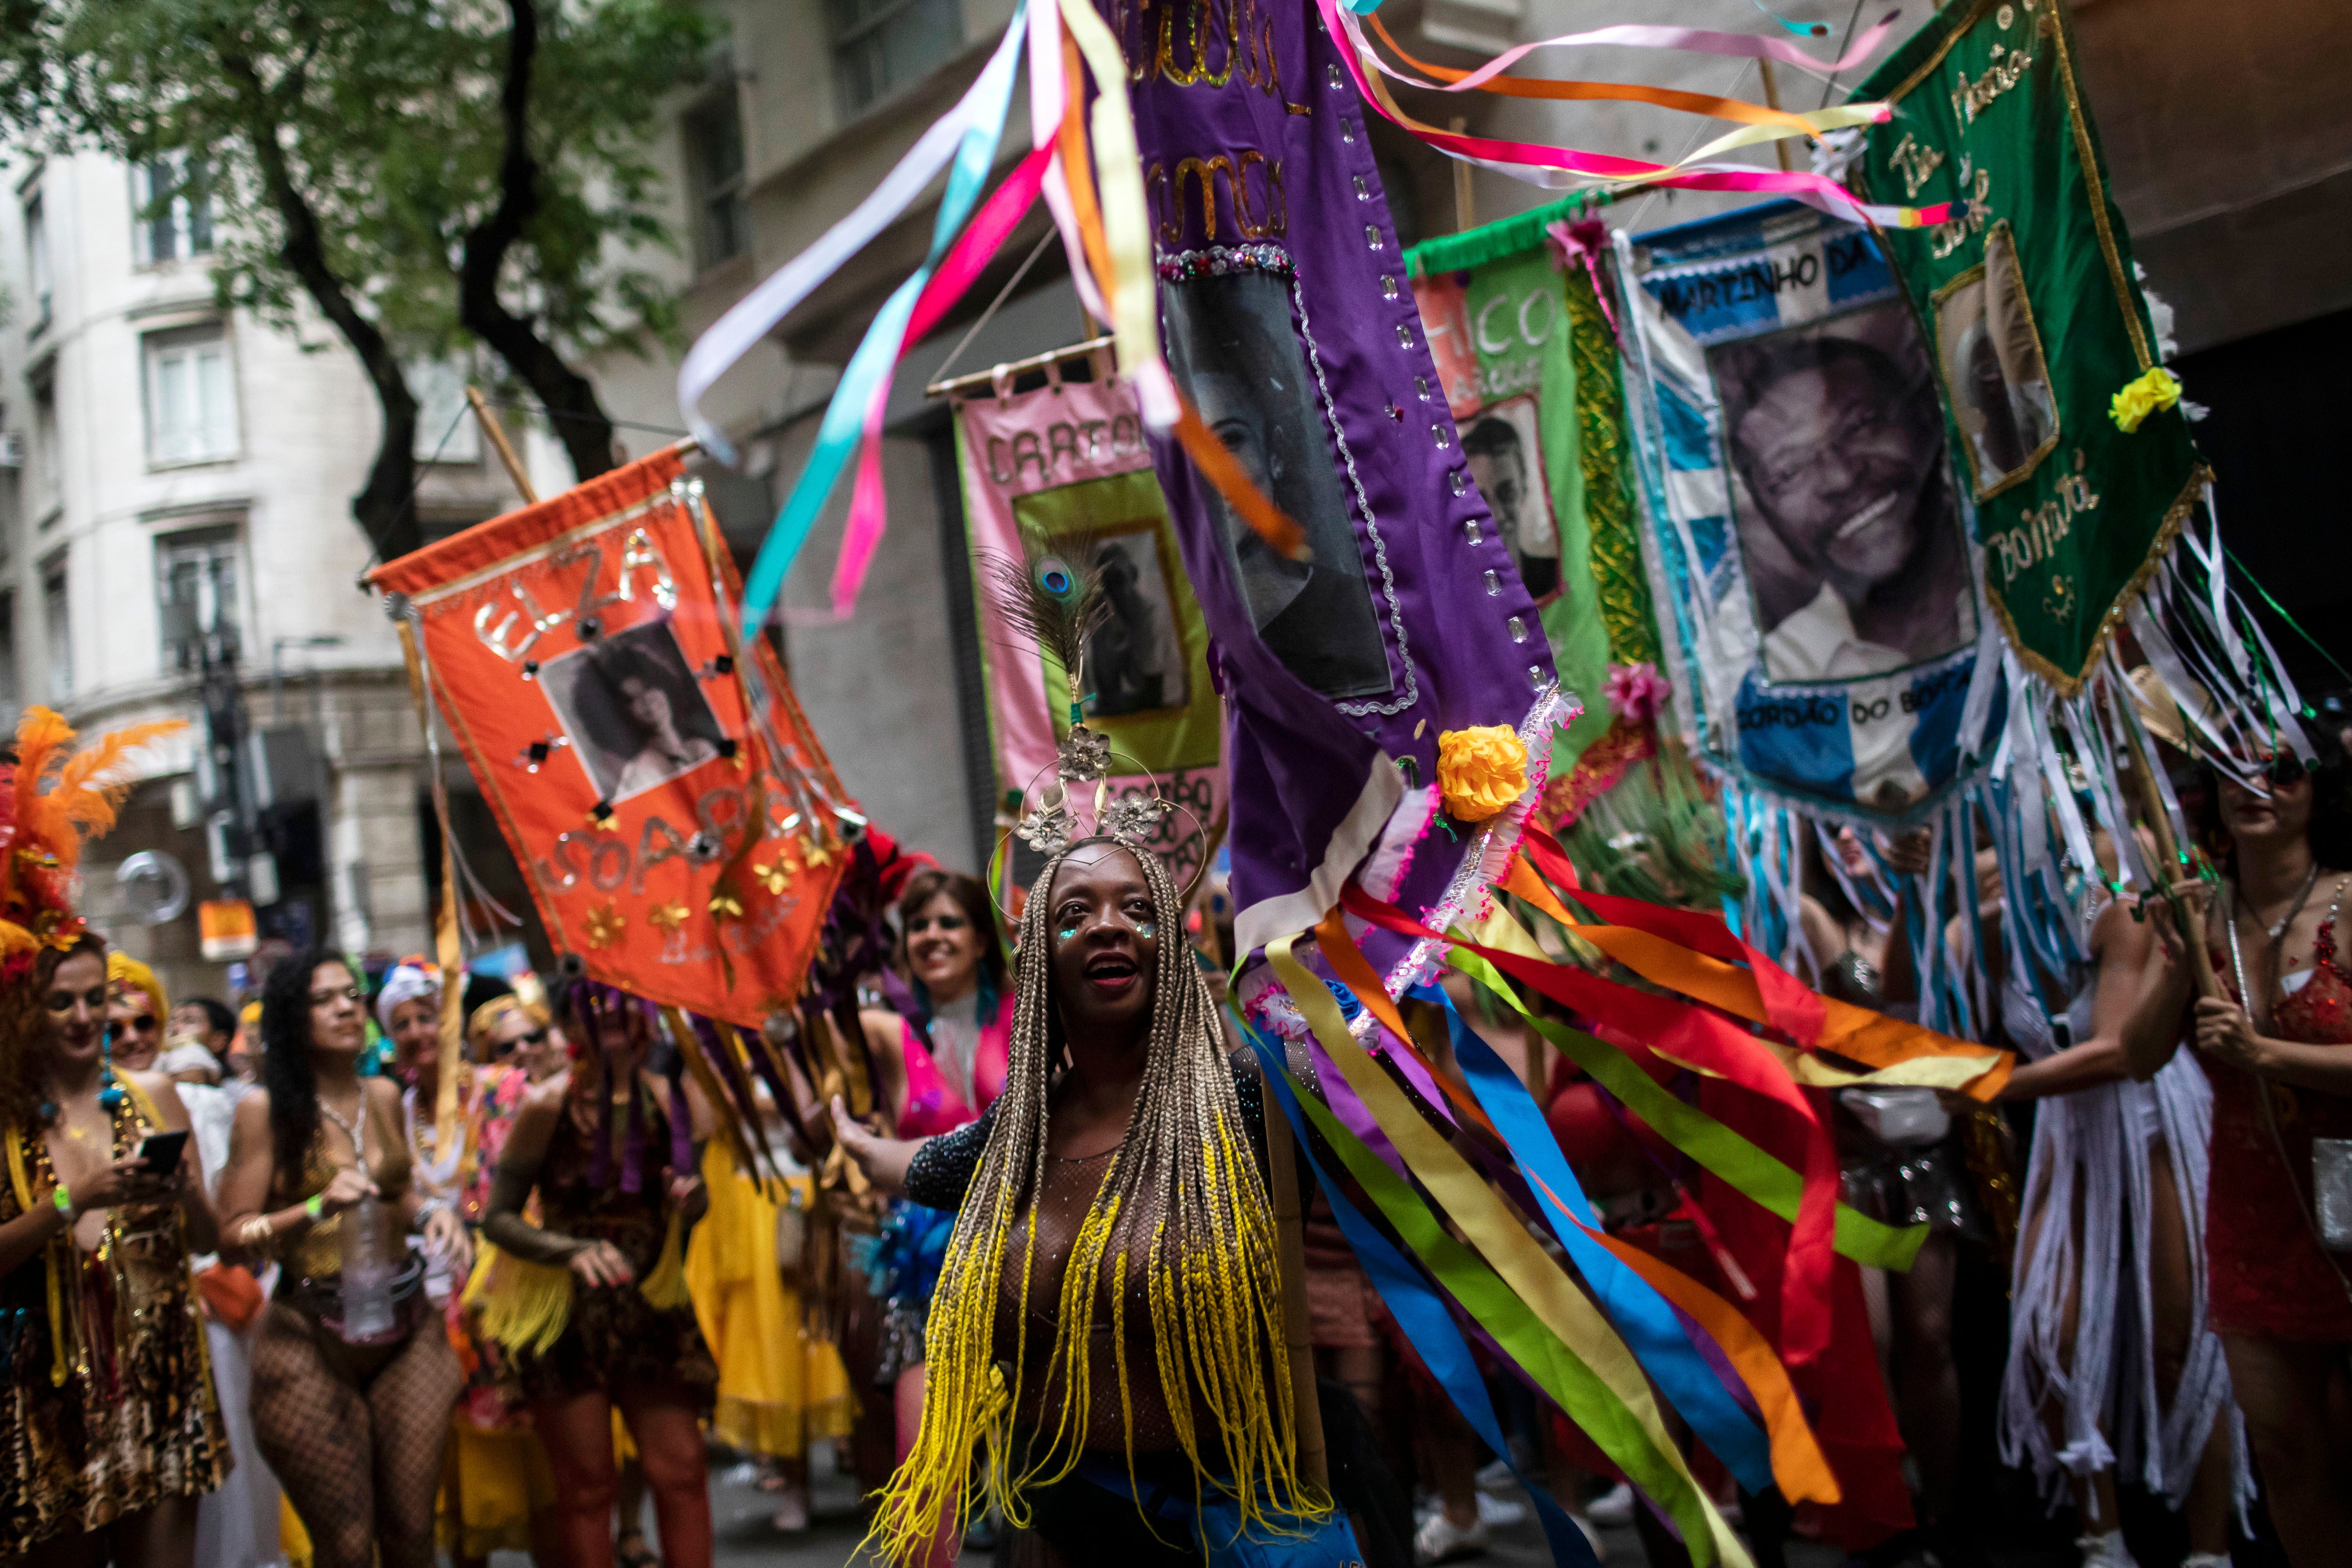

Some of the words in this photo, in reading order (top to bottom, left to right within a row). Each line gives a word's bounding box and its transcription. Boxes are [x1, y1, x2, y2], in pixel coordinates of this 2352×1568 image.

[1660, 253, 1819, 322] MARTINHO
[1829, 237, 1867, 277] DA
[1420, 286, 1555, 368] HICO
[473, 527, 678, 661] ELZA
[1852, 698, 1891, 725] DO
